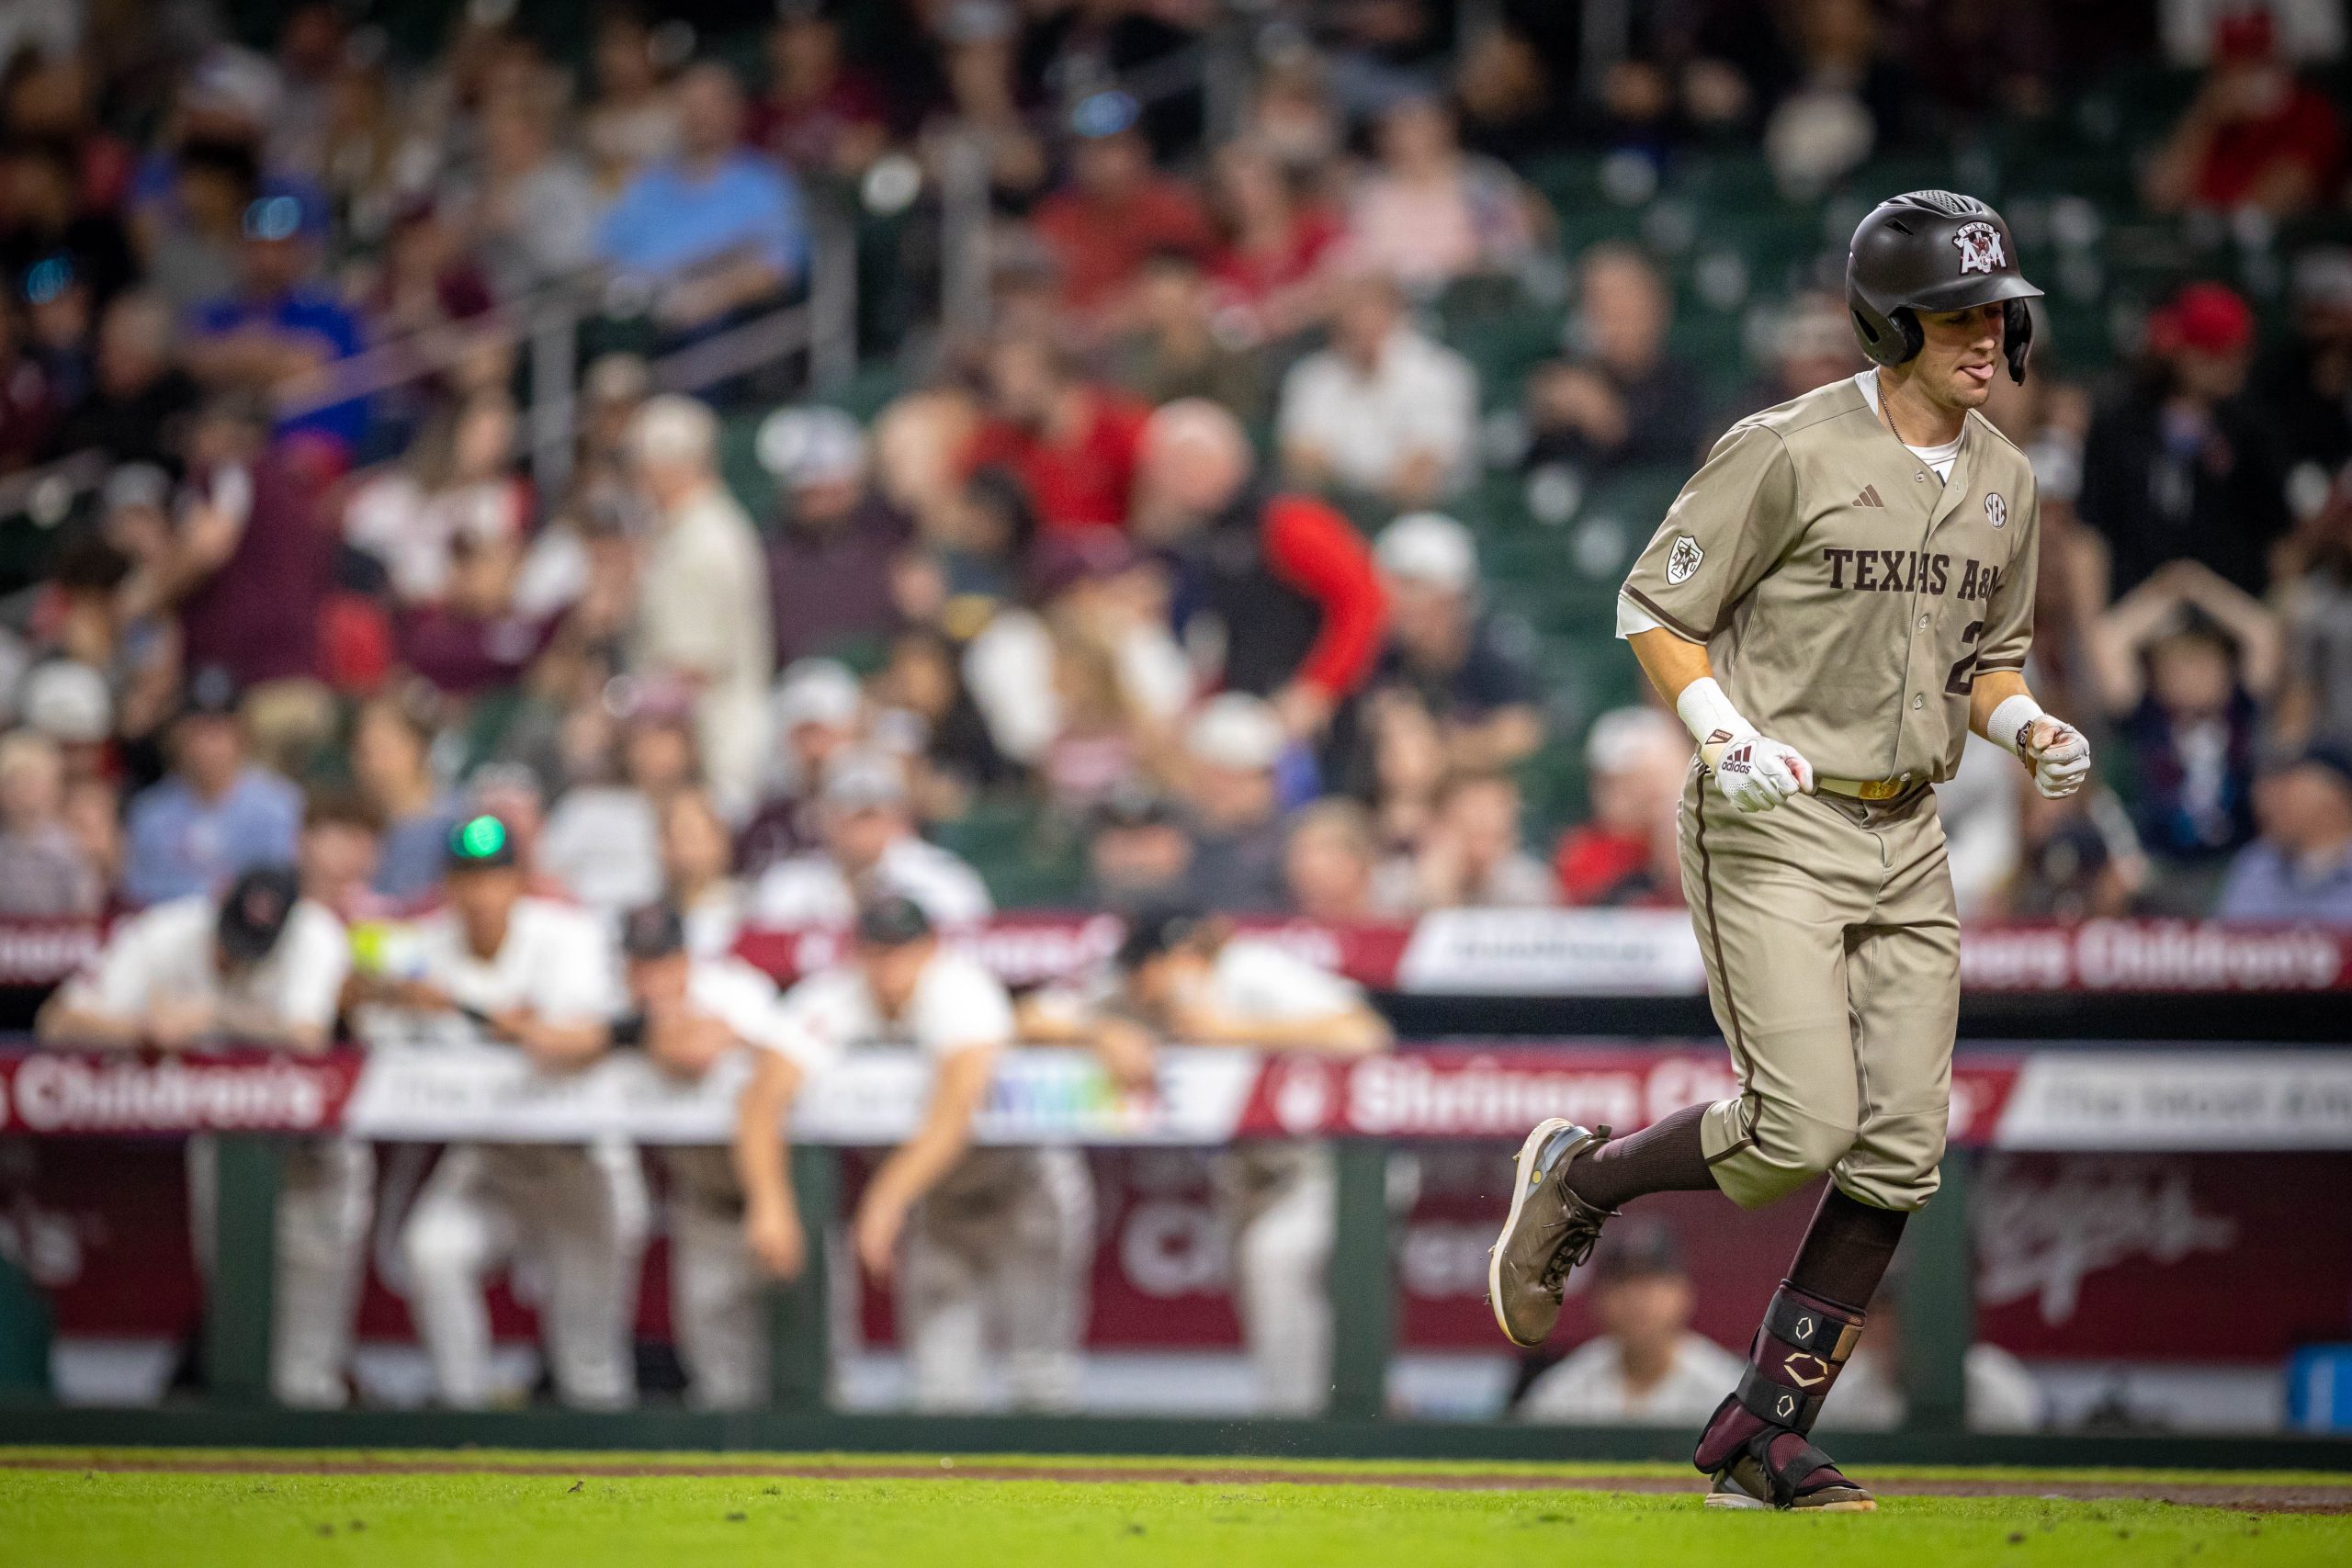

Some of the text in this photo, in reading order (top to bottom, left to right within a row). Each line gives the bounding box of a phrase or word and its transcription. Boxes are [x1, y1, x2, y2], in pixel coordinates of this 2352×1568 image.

[1962, 222, 1991, 234] TEXAS
[1984, 492, 2007, 528] SEC
[1824, 548, 1950, 595] TEXAS
[1721, 760, 1752, 774] adidas
[13, 1056, 327, 1130] Children's
[1348, 1054, 1637, 1134] Shriners
